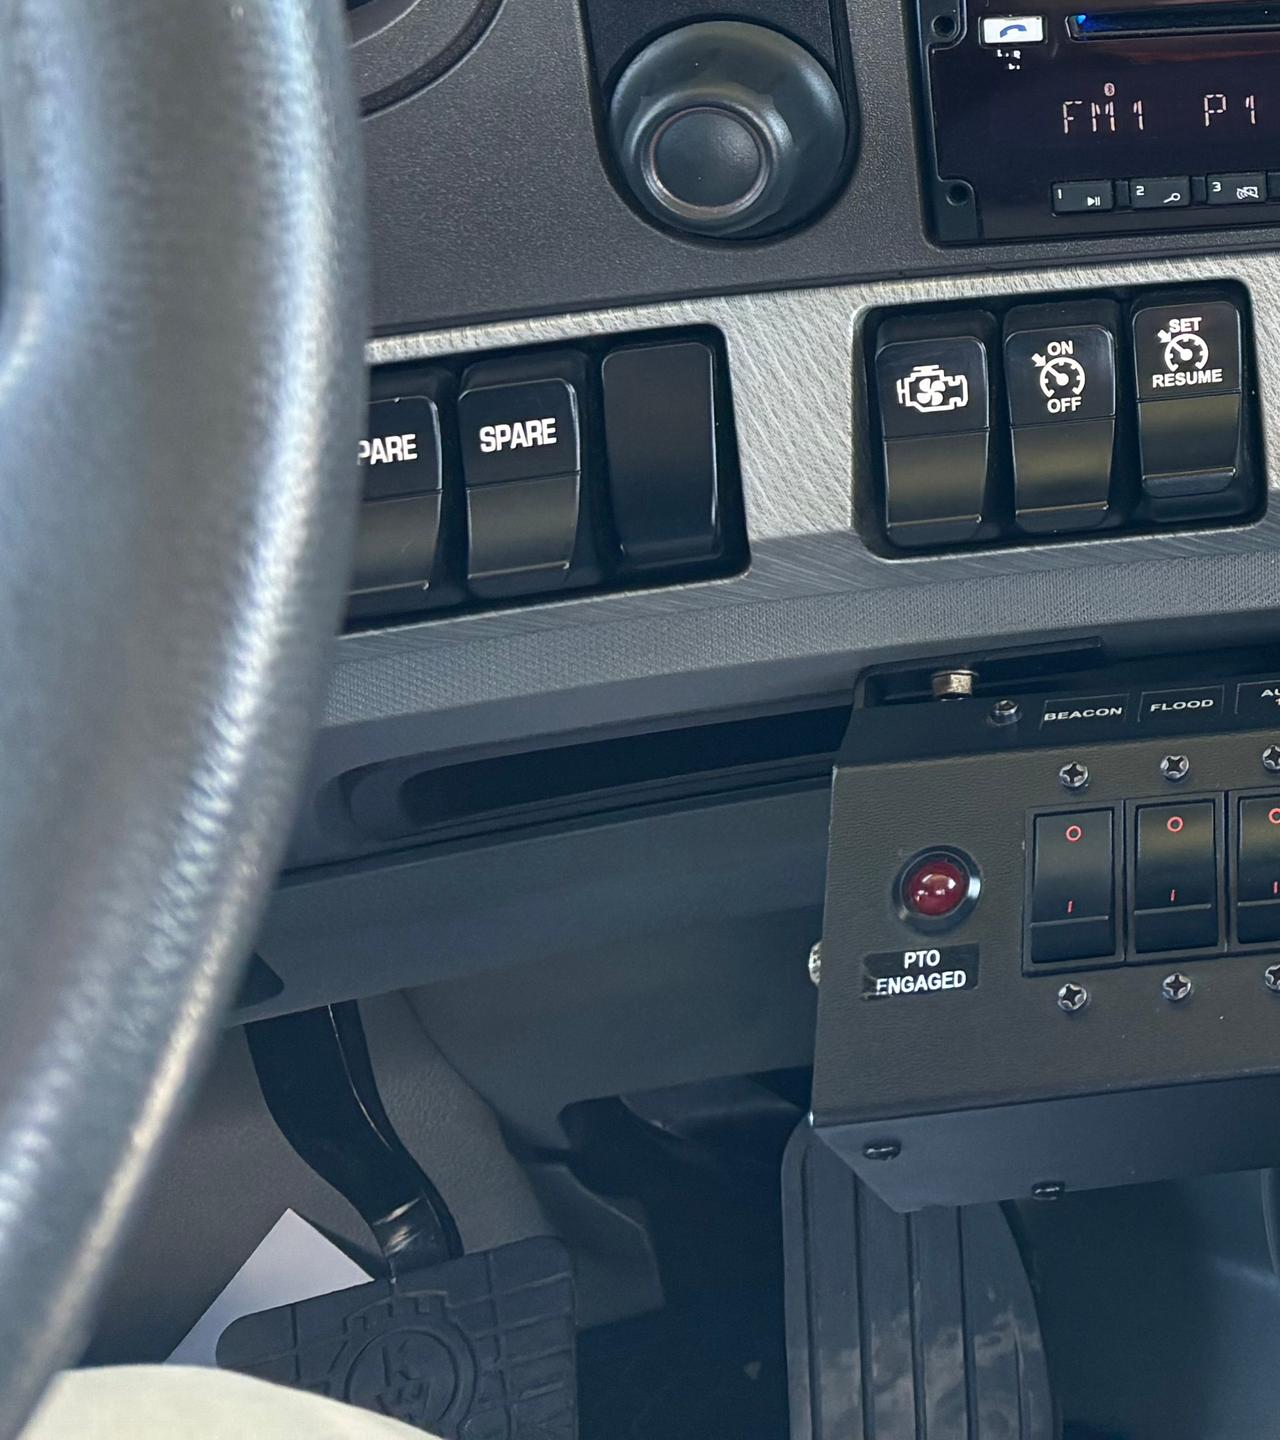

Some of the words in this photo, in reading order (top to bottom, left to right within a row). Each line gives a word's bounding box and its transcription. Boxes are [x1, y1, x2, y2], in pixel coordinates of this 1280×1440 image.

[1056, 189, 1063, 200] 1
[1136, 185, 1145, 196] 2
[1212, 181, 1222, 192] 3
[1168, 317, 1202, 334] SET
[1047, 340, 1074, 356] ON
[1152, 368, 1223, 388] RESUME
[1046, 397, 1082, 414] OFF
[479, 417, 557, 453] SPARE
[357, 433, 418, 466] PARE
[1043, 707, 1123, 722] BEACON
[1150, 699, 1214, 713] FLOOD
[904, 949, 941, 969] PTO
[875, 970, 967, 996] ENGAGED
